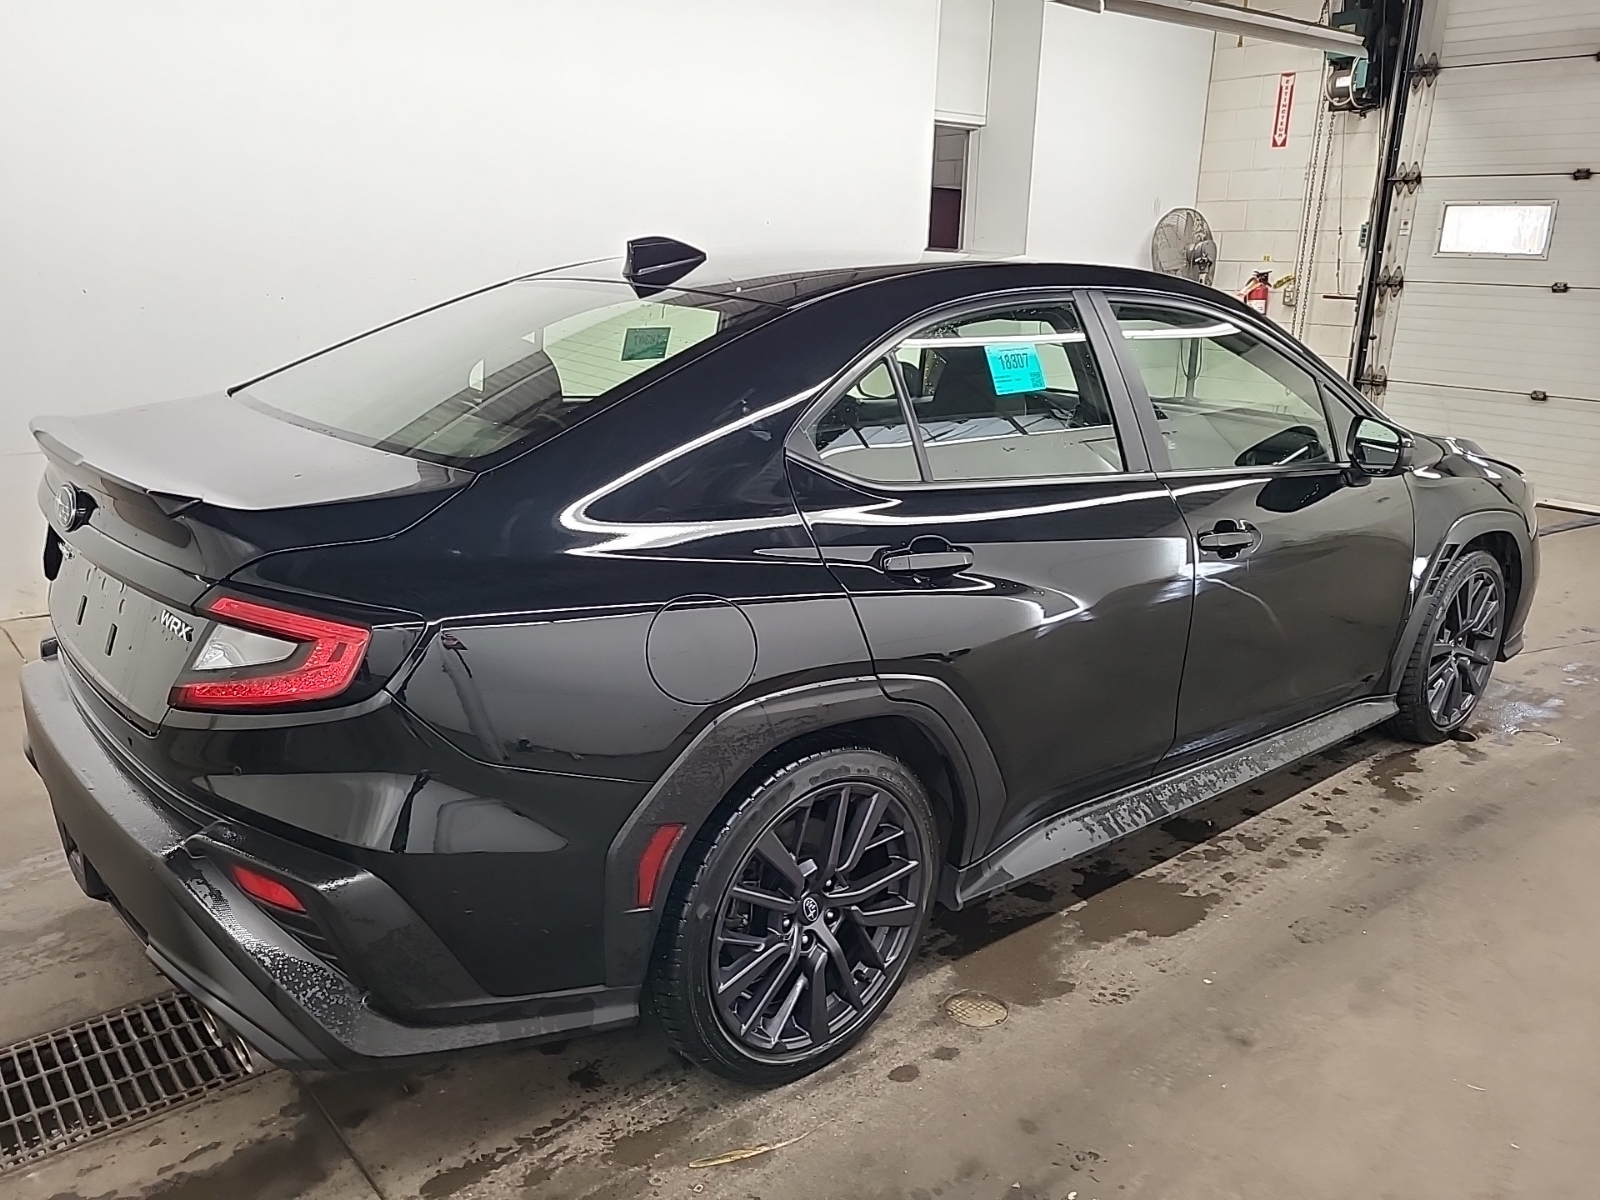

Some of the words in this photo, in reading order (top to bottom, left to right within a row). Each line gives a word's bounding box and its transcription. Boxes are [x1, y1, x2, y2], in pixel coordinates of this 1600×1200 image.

[1277, 79, 1290, 138] EXTINCTEUR
[998, 353, 1029, 370] 18307
[160, 609, 193, 642] WRX
